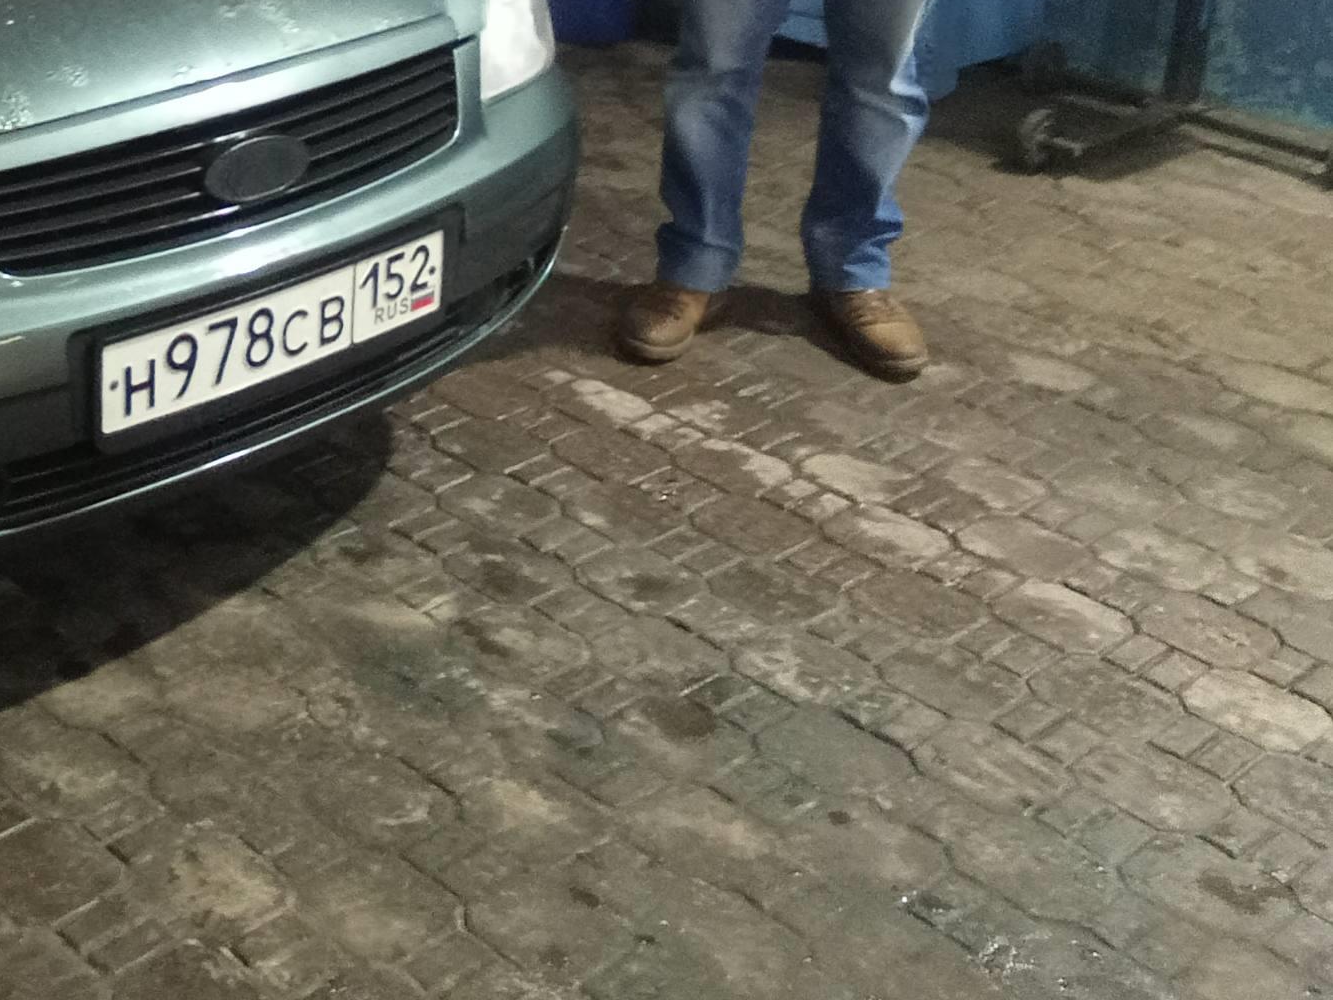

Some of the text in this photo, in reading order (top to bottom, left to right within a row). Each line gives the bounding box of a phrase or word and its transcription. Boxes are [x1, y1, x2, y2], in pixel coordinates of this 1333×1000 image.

[124, 244, 430, 417] Н978СВ 152
[374, 297, 409, 325] RUS
